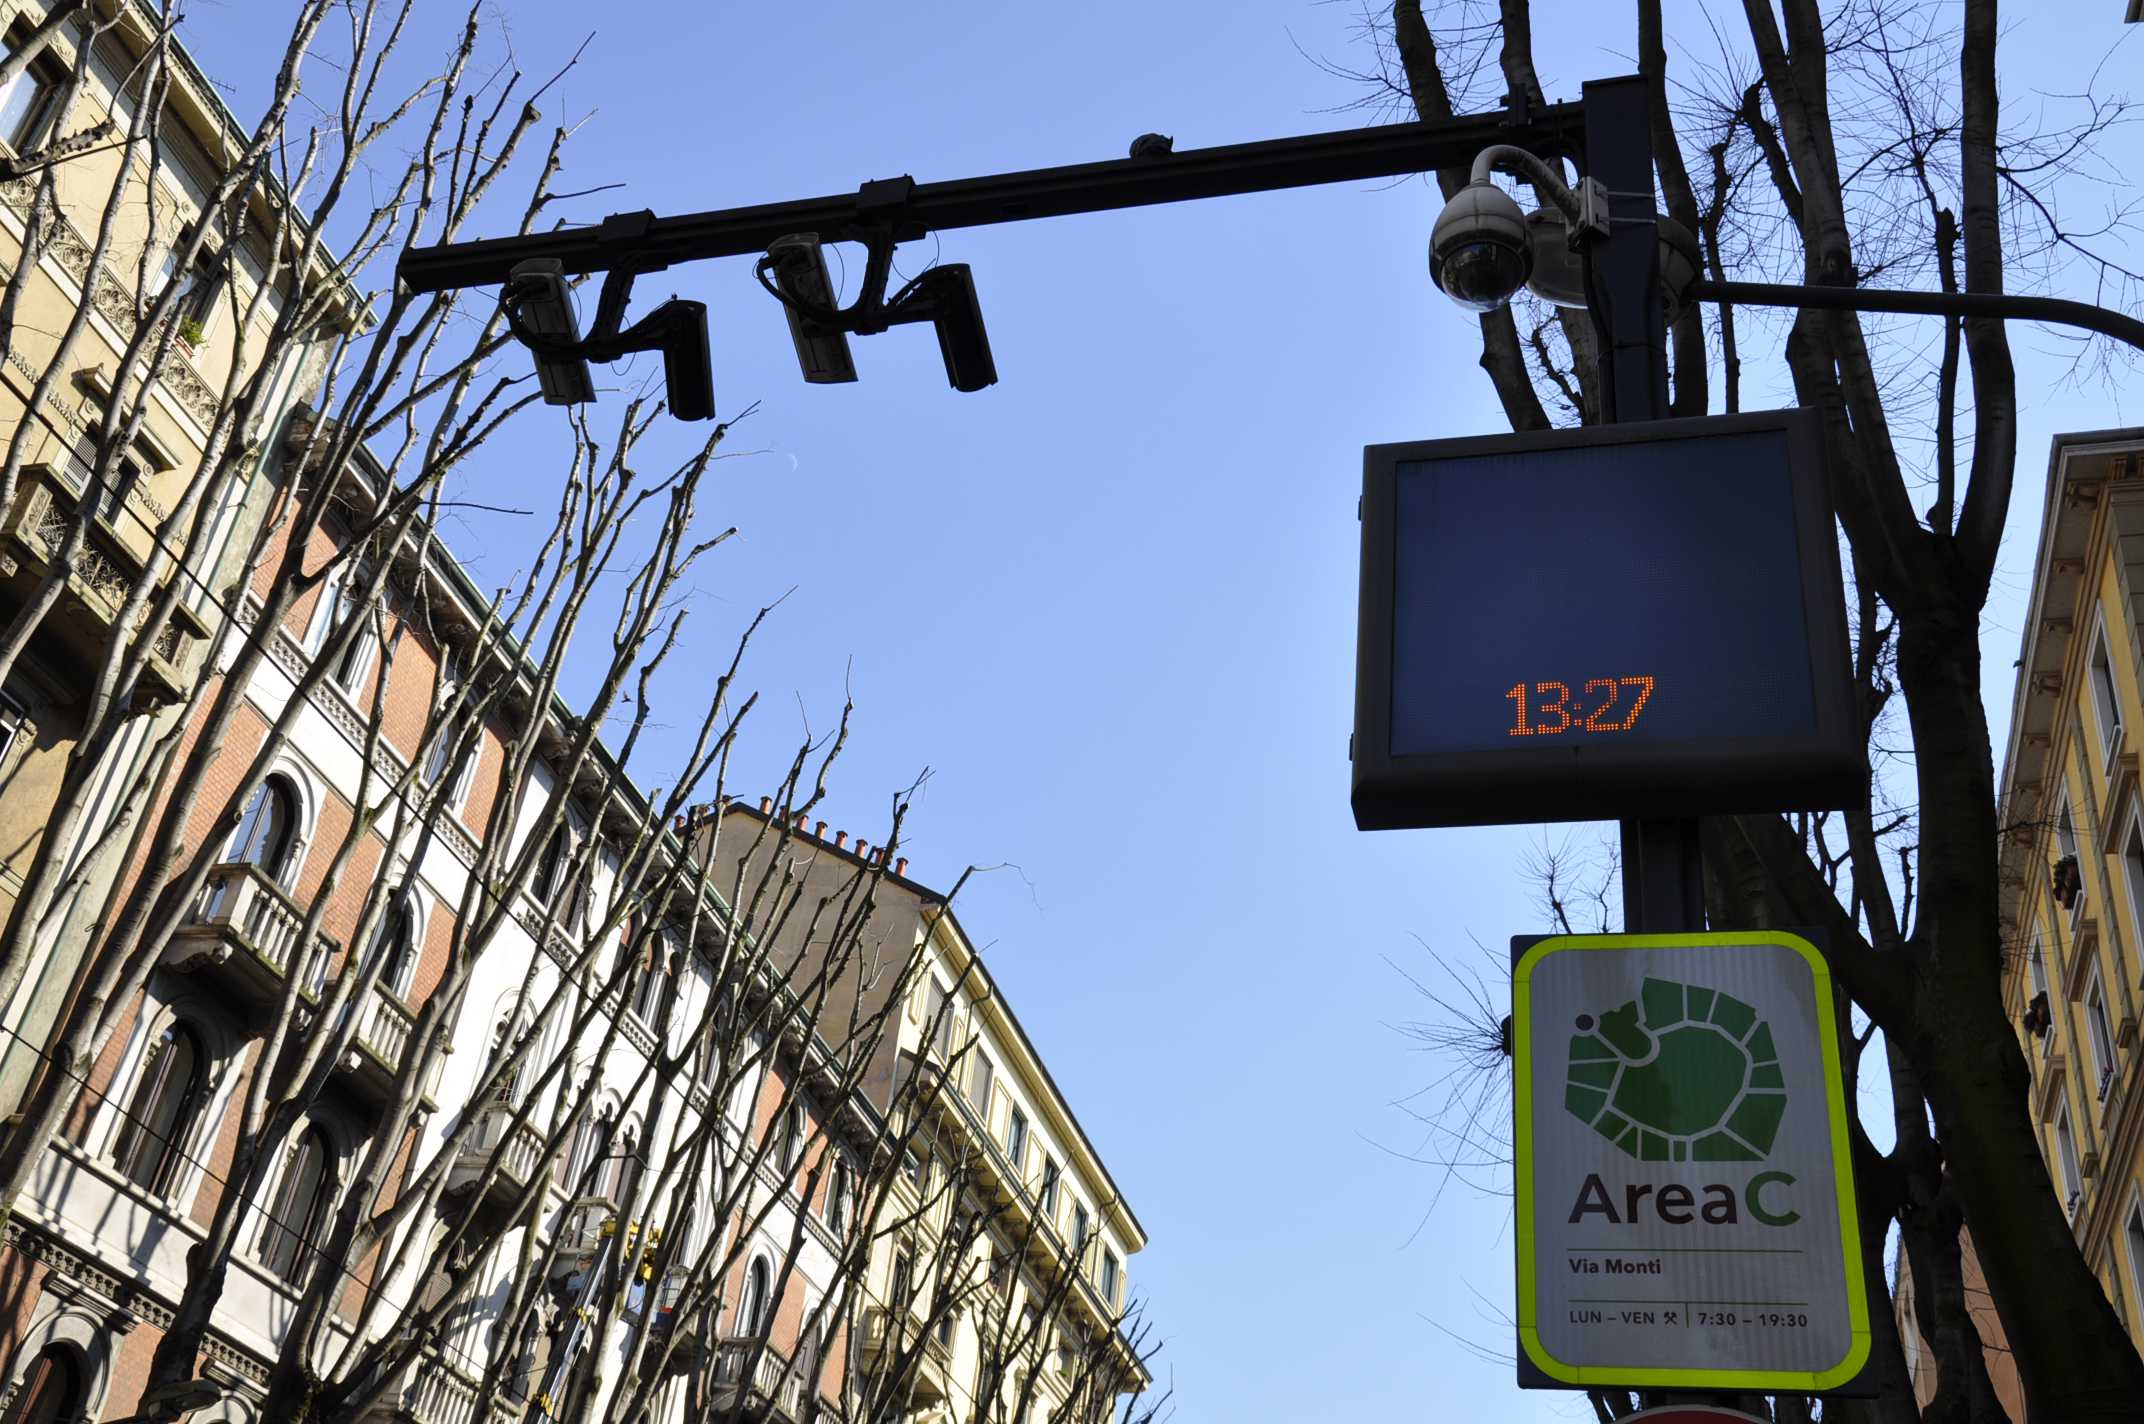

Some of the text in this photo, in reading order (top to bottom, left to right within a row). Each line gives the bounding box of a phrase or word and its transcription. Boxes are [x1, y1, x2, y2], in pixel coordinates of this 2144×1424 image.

[1505, 675, 1654, 736] 13:27
[1569, 1258, 1661, 1275] Via Monti
[1570, 1311, 1601, 1324] LUN
[1622, 1312, 1655, 1325] VEN
[1698, 1313, 1736, 1326] 7:30
[1759, 1314, 1808, 1327] 19:30
